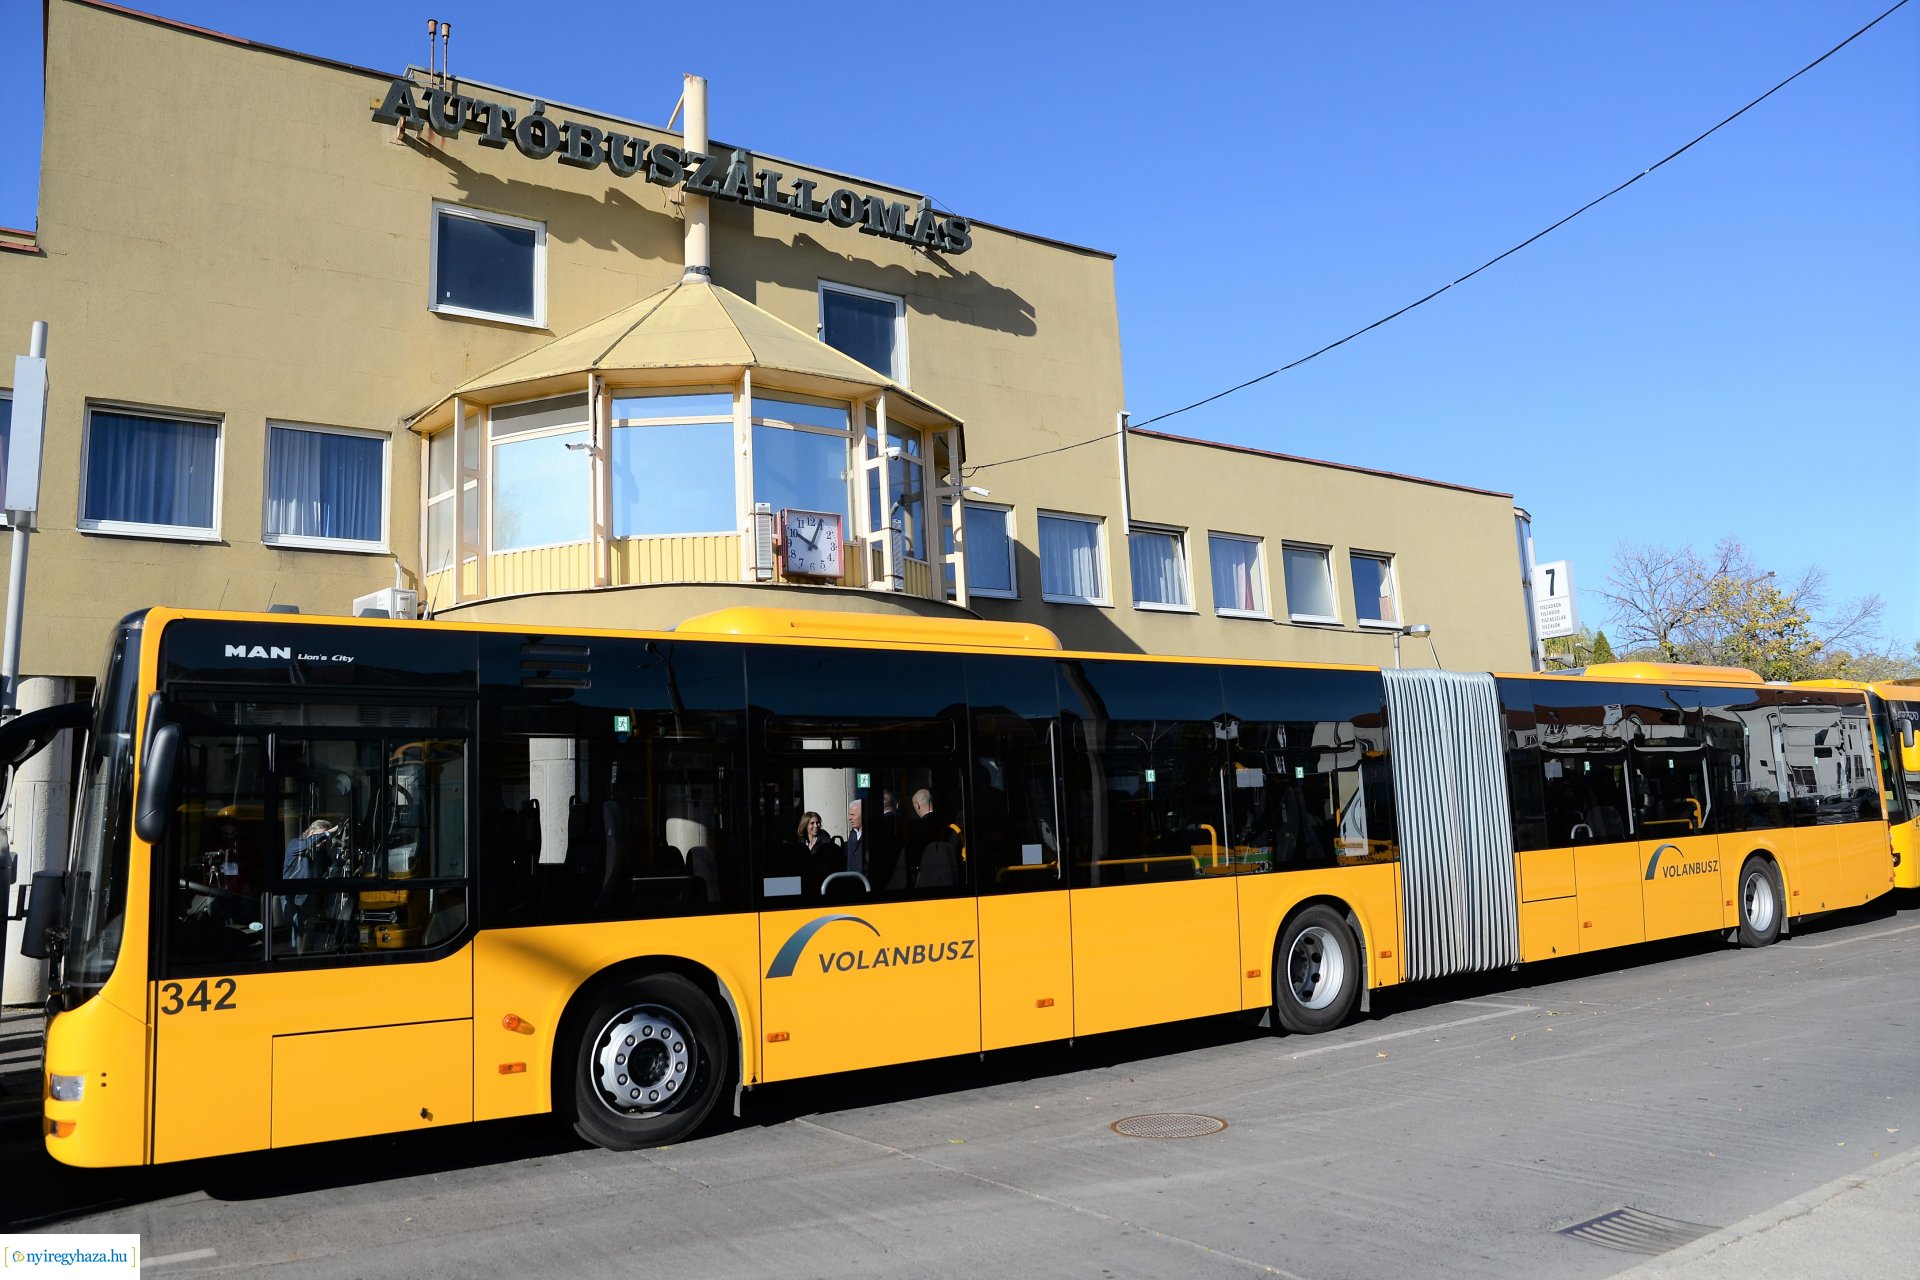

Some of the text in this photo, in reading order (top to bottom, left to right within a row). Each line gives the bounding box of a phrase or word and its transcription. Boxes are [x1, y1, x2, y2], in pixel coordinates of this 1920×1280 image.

[371, 79, 973, 255] AUTÓBUSZÁLLOMÁS
[798, 520, 804, 528] 11
[807, 517, 815, 526] 12
[790, 529, 798, 537] 10
[826, 531, 832, 539] 2
[787, 539, 792, 547] 9
[831, 542, 836, 551] 3
[791, 550, 796, 558] 8
[827, 553, 832, 561] 4
[799, 558, 804, 567] 7
[810, 563, 815, 571] 6
[820, 560, 825, 569] 5
[1545, 568, 1555, 596] 7
[225, 644, 355, 663] MAN Lion's City
[819, 940, 976, 973] VOLÁNBUSZ
[161, 978, 237, 1015] 342
